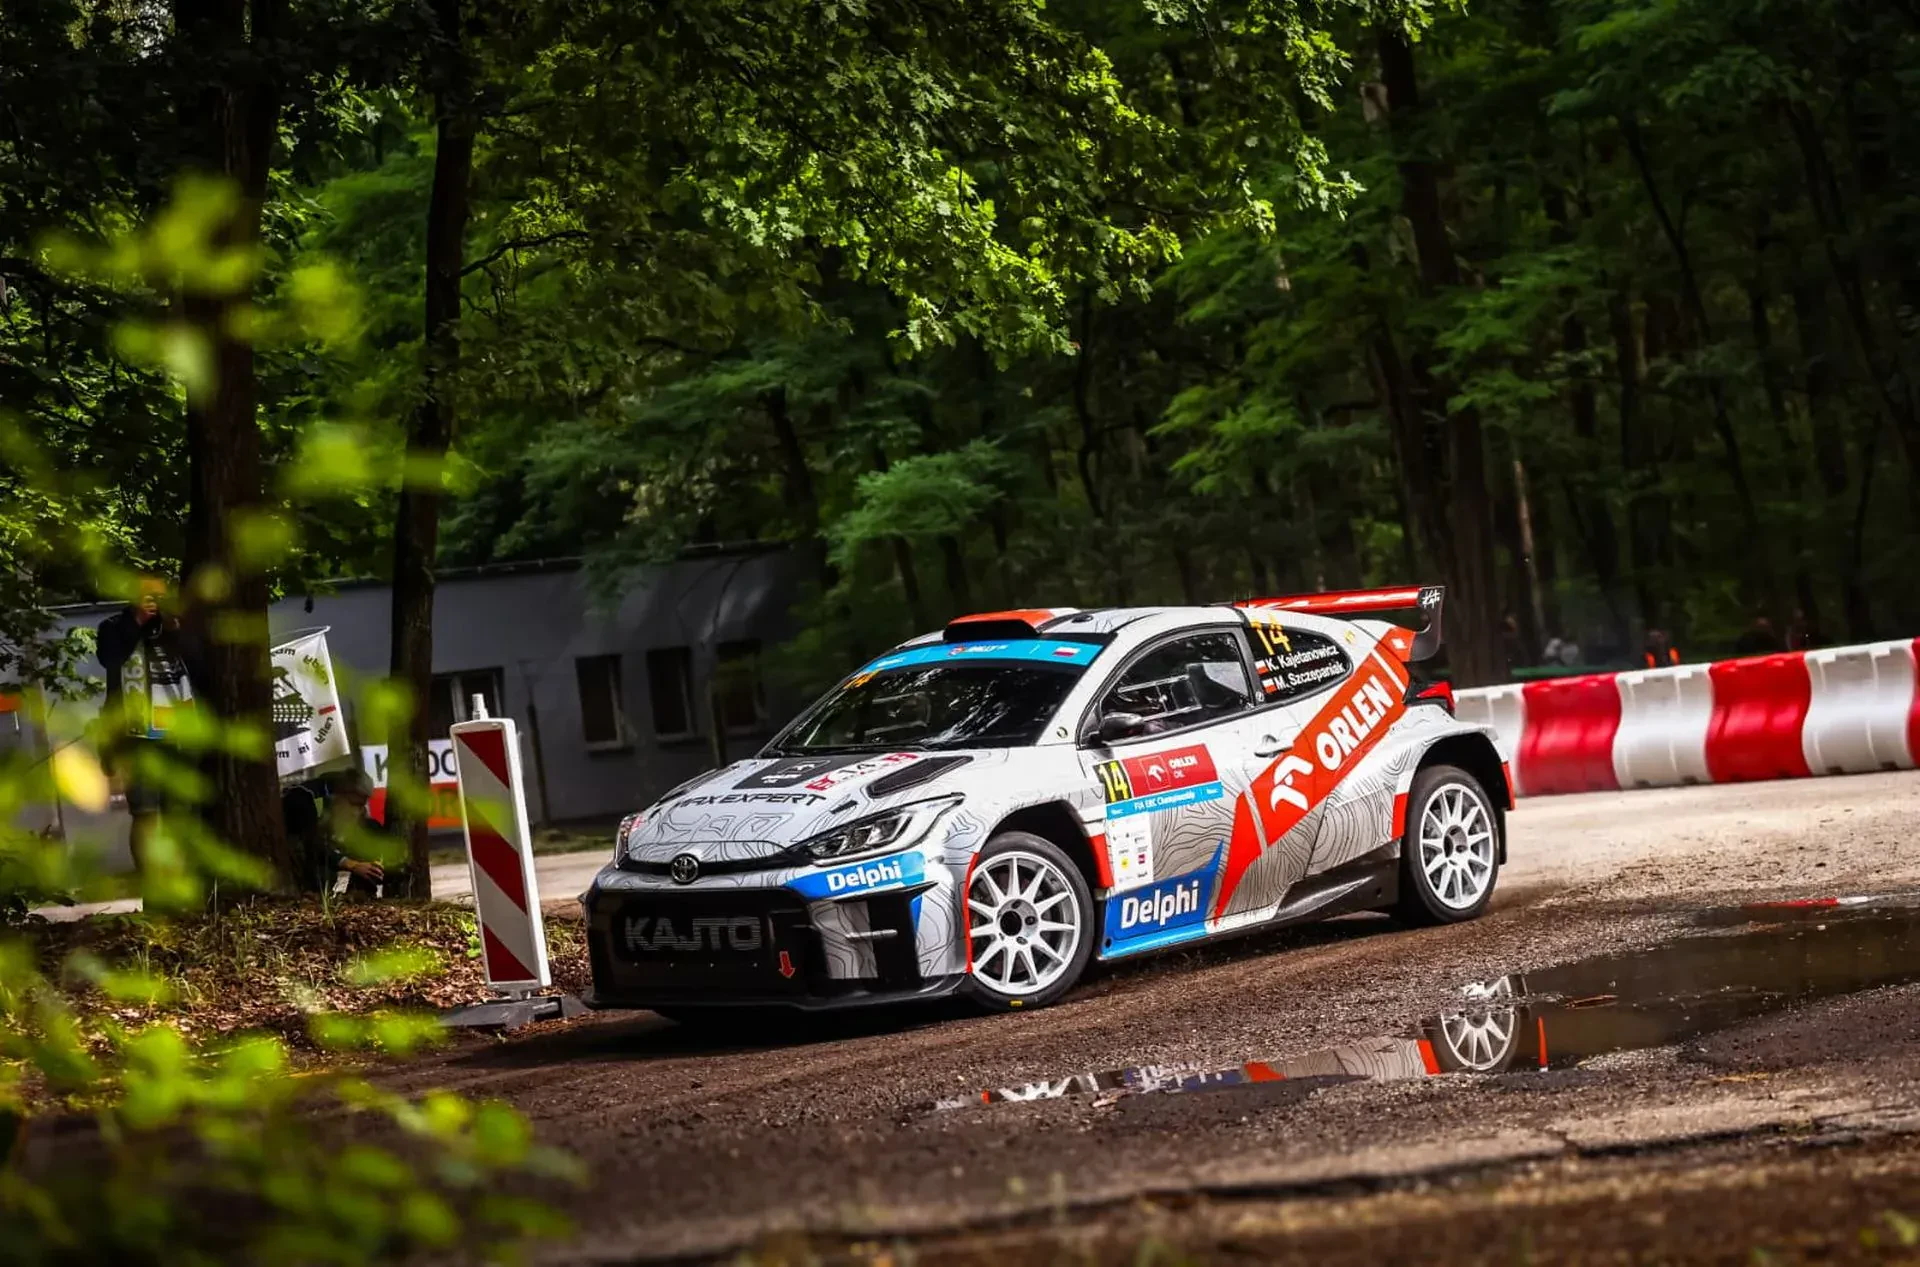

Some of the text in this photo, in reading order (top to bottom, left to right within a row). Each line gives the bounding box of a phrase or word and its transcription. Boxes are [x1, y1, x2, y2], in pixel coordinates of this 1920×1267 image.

[1251, 613, 1292, 656] 14
[1266, 644, 1340, 672] K. Kajetanowicz
[1274, 661, 1346, 690] M. Szczepaniak
[1316, 674, 1395, 771] ORLEN
[1168, 754, 1198, 770] ORLEN
[1098, 760, 1130, 803] 14
[826, 860, 902, 892] Delphi
[1120, 880, 1199, 929] Delphi
[625, 917, 760, 950] KAJTO
